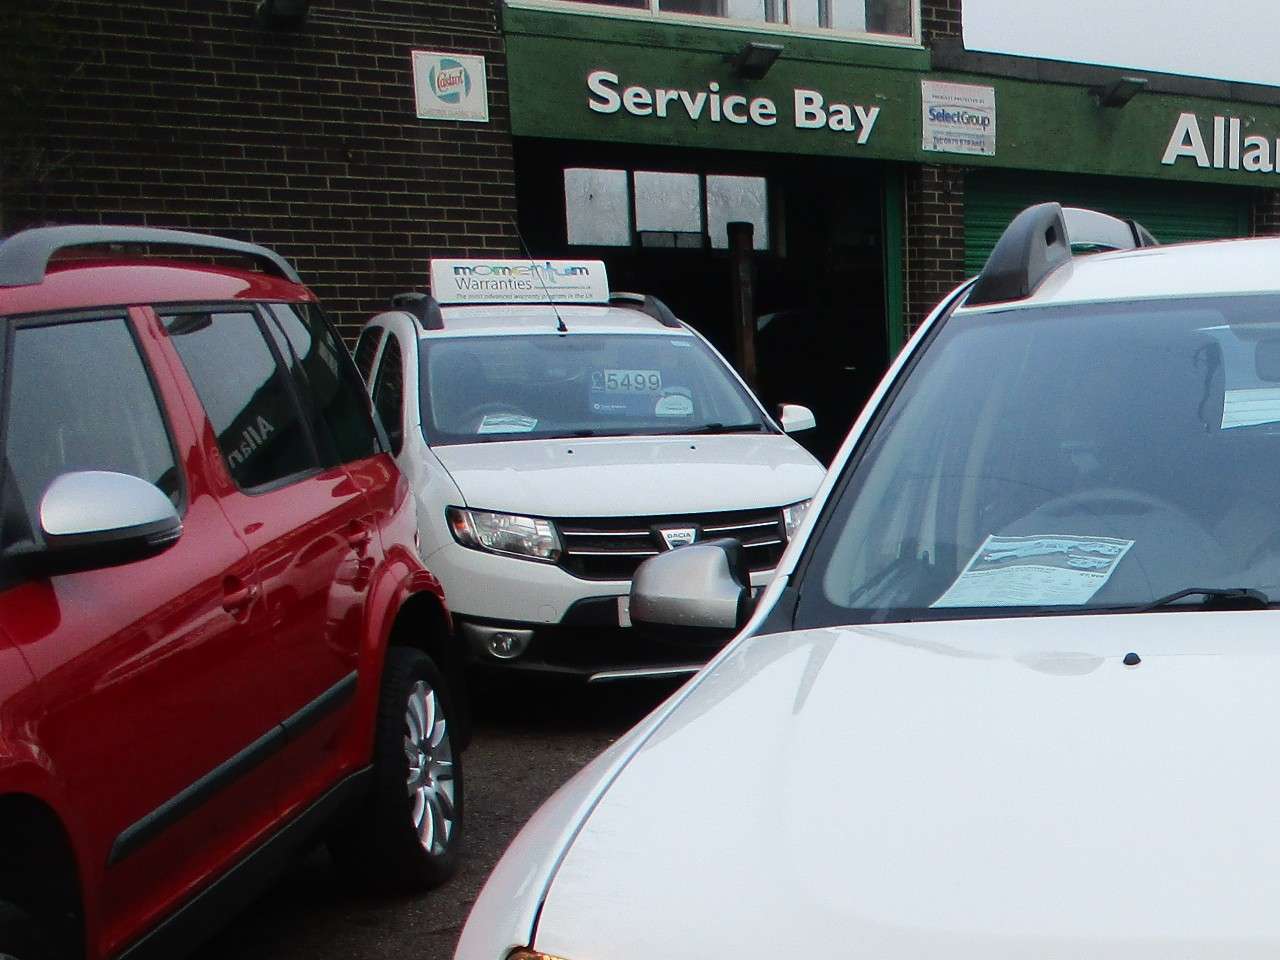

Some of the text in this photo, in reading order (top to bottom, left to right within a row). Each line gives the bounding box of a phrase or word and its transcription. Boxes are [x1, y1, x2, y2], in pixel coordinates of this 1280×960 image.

[586, 70, 880, 144] Service Bay
[455, 278, 532, 290] Warranties
